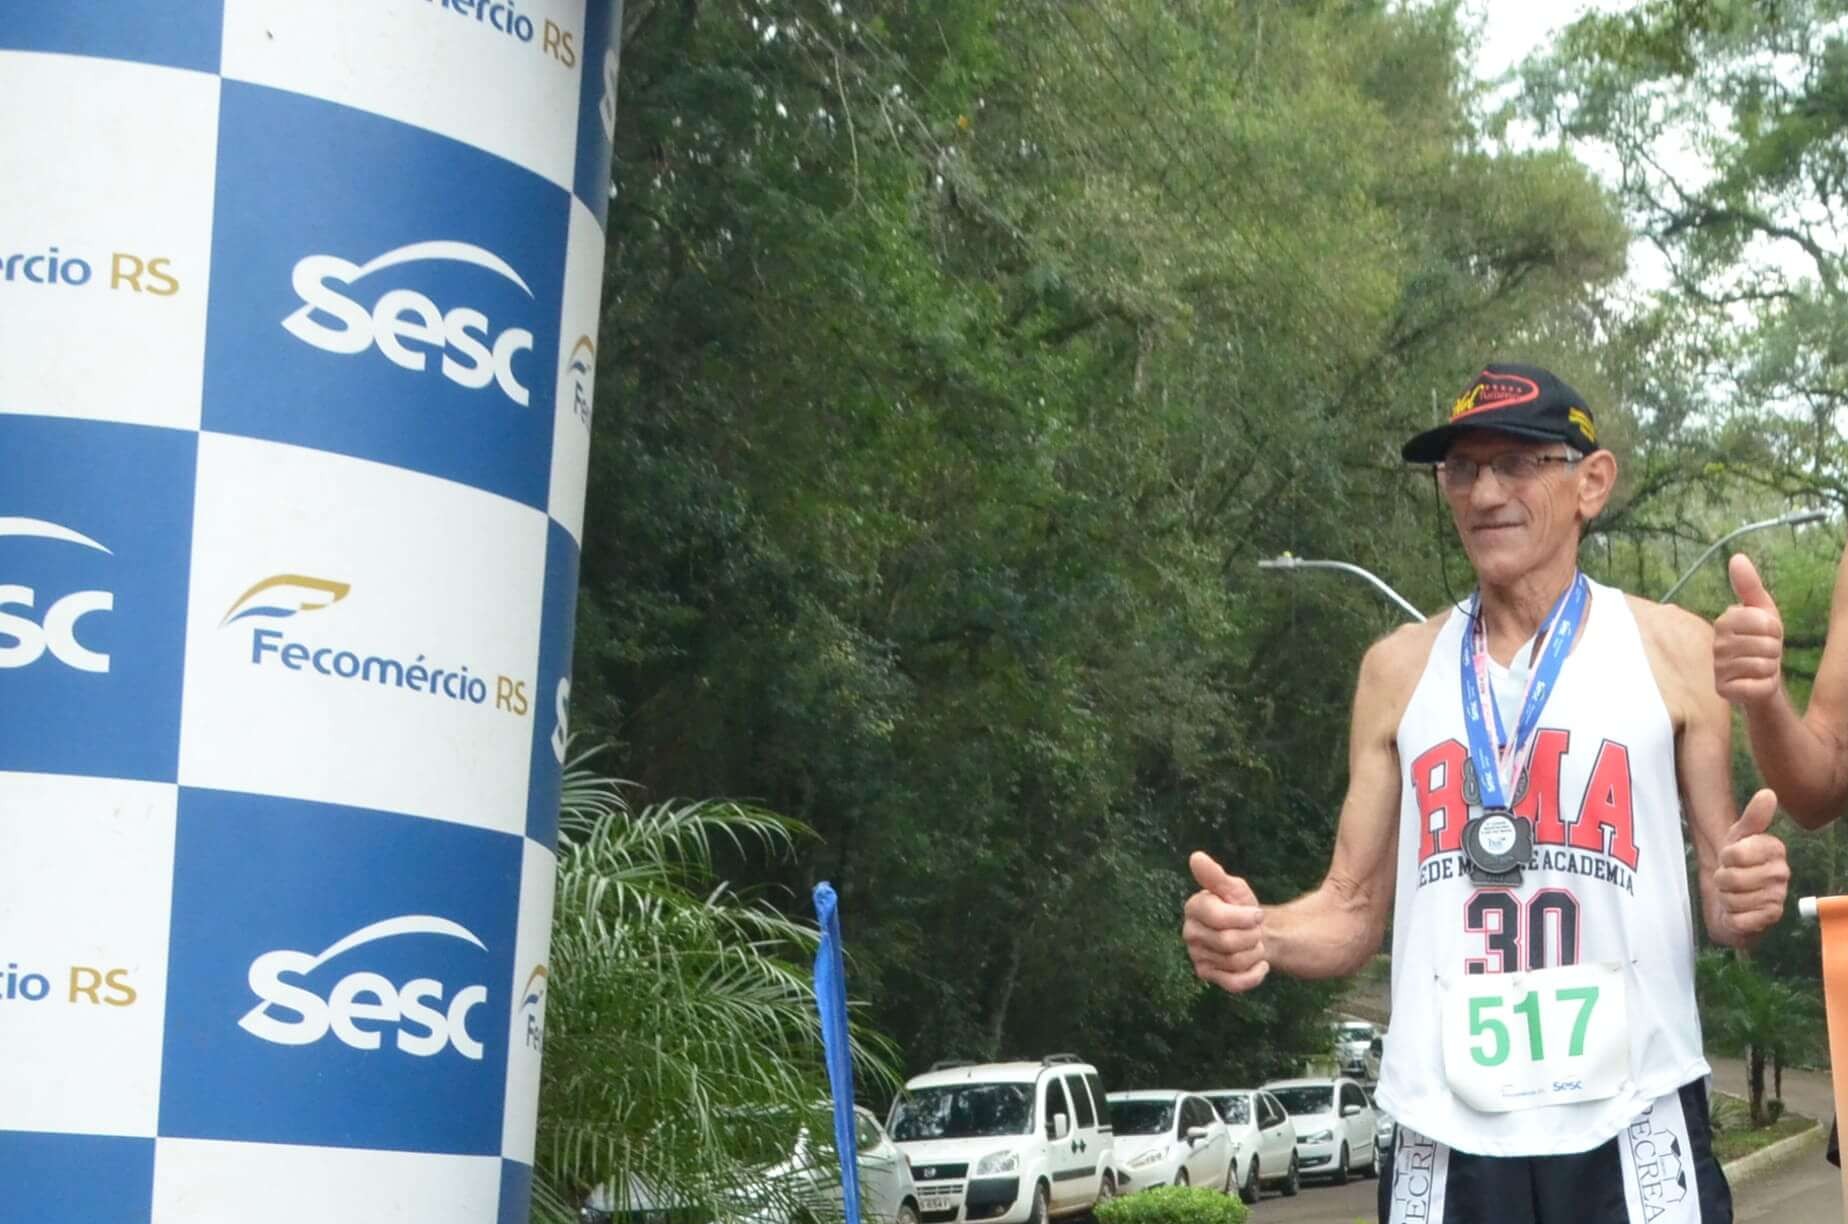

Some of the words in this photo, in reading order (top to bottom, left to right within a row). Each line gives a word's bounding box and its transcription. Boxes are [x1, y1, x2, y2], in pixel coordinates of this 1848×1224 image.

[543, 18, 577, 69] RS
[110, 252, 180, 296] RS
[281, 250, 534, 407] Sesc
[251, 629, 487, 704] Fecomércio
[496, 675, 529, 717] RS
[1542, 852, 1635, 897] ACADEMIA
[1464, 888, 1581, 975] 30
[68, 966, 137, 1007] RS
[238, 946, 488, 1060] Sesc
[1468, 986, 1600, 1067] 517
